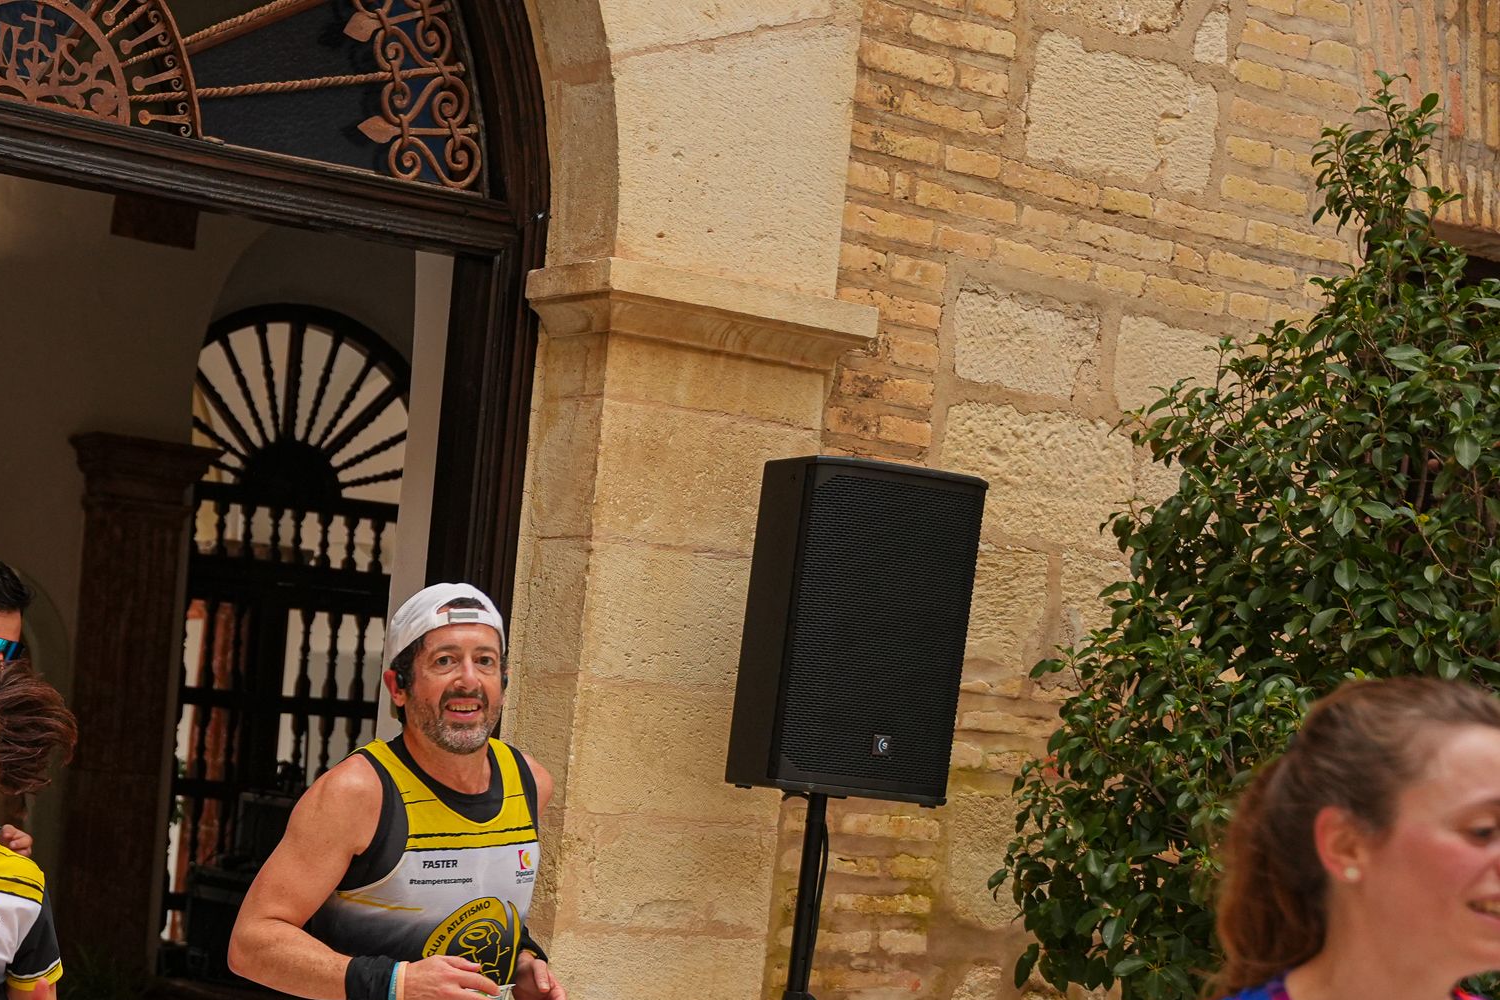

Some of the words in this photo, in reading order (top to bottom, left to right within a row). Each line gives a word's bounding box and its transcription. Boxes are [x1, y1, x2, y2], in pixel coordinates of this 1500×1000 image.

[422, 859, 458, 869] FASTER
[409, 877, 473, 886] #teamperezcampos
[426, 934, 447, 957] CLUB
[446, 900, 491, 935] ATLETISMO
